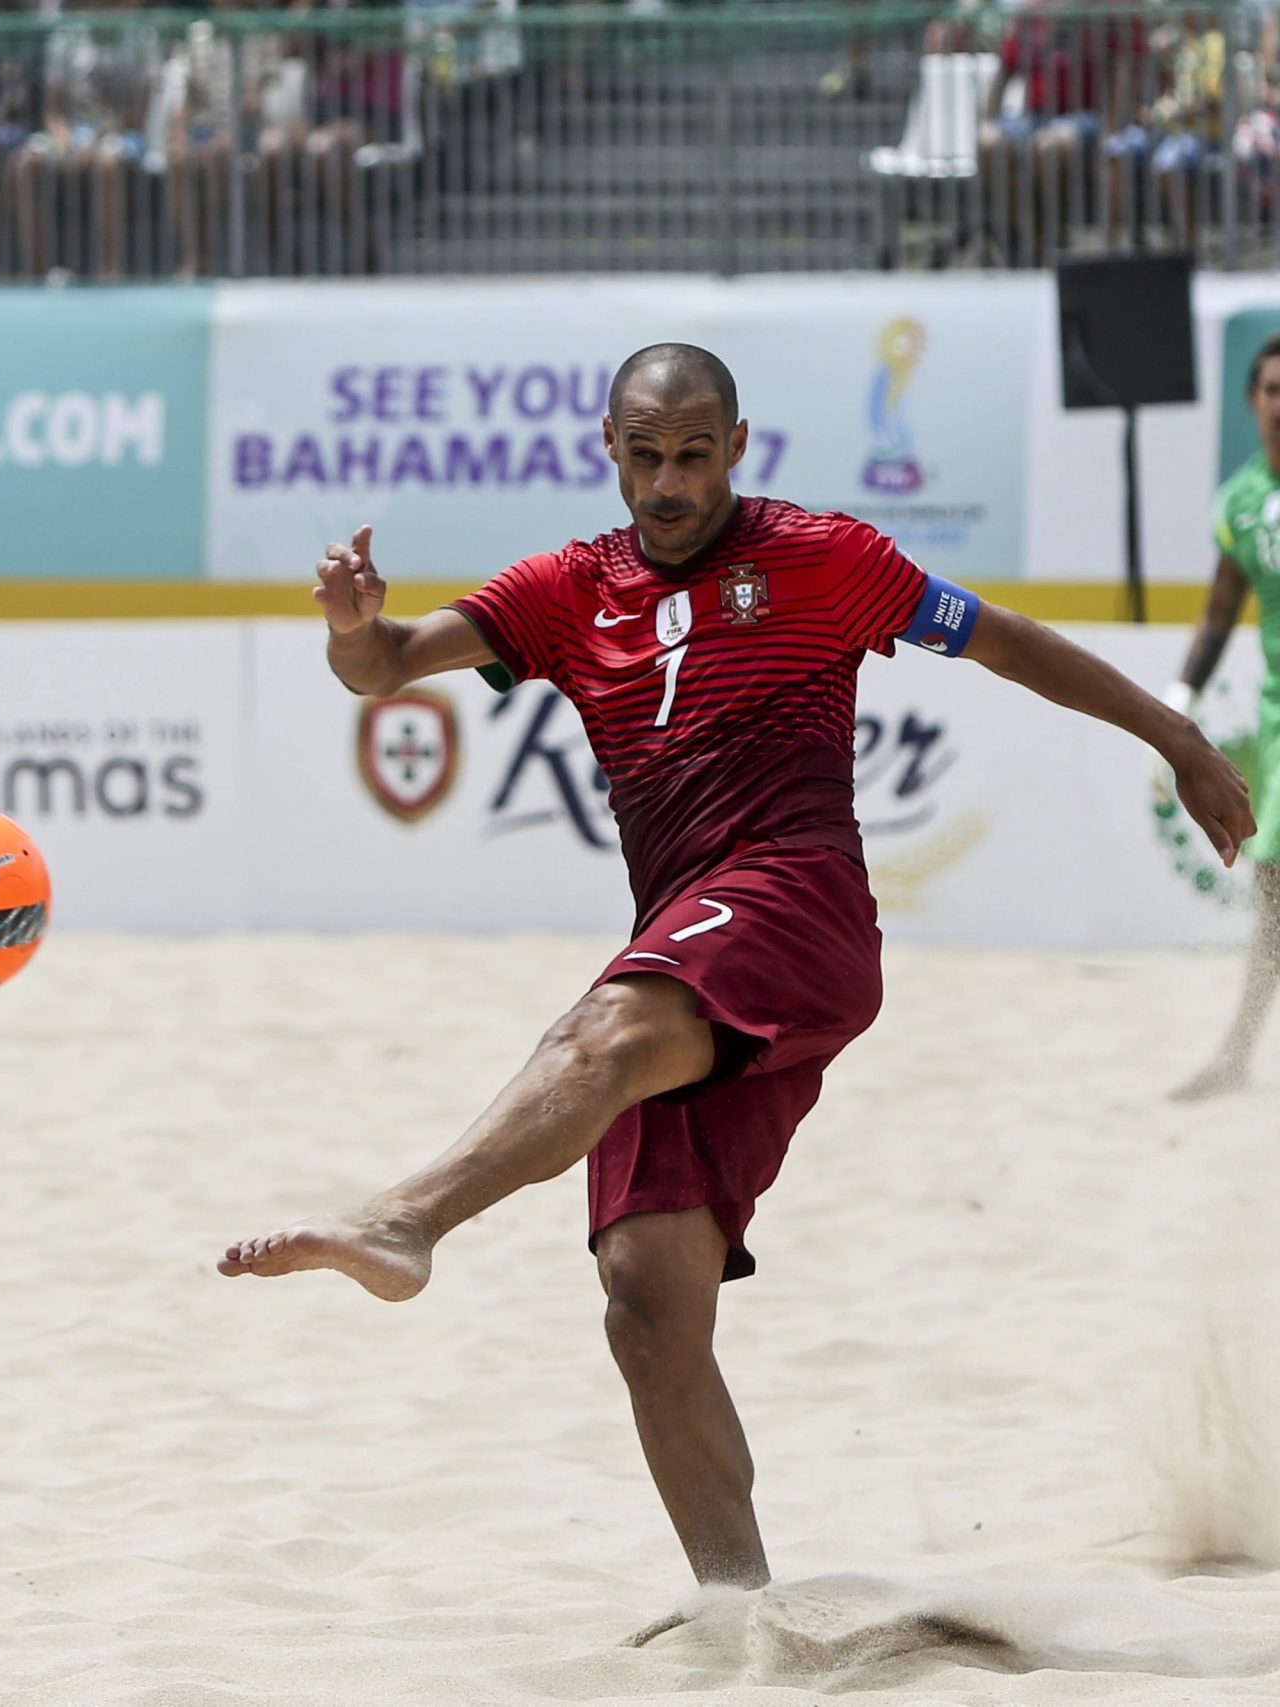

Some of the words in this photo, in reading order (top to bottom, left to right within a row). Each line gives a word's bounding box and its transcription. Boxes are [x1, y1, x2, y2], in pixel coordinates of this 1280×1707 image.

[331, 366, 447, 424] SEE
[466, 366, 611, 422] YOU
[234, 433, 612, 488] BAHAMAS
[933, 591, 950, 624] UNITE
[950, 598, 966, 631] RACISM
[654, 644, 689, 727] 7
[668, 898, 734, 942] 7
